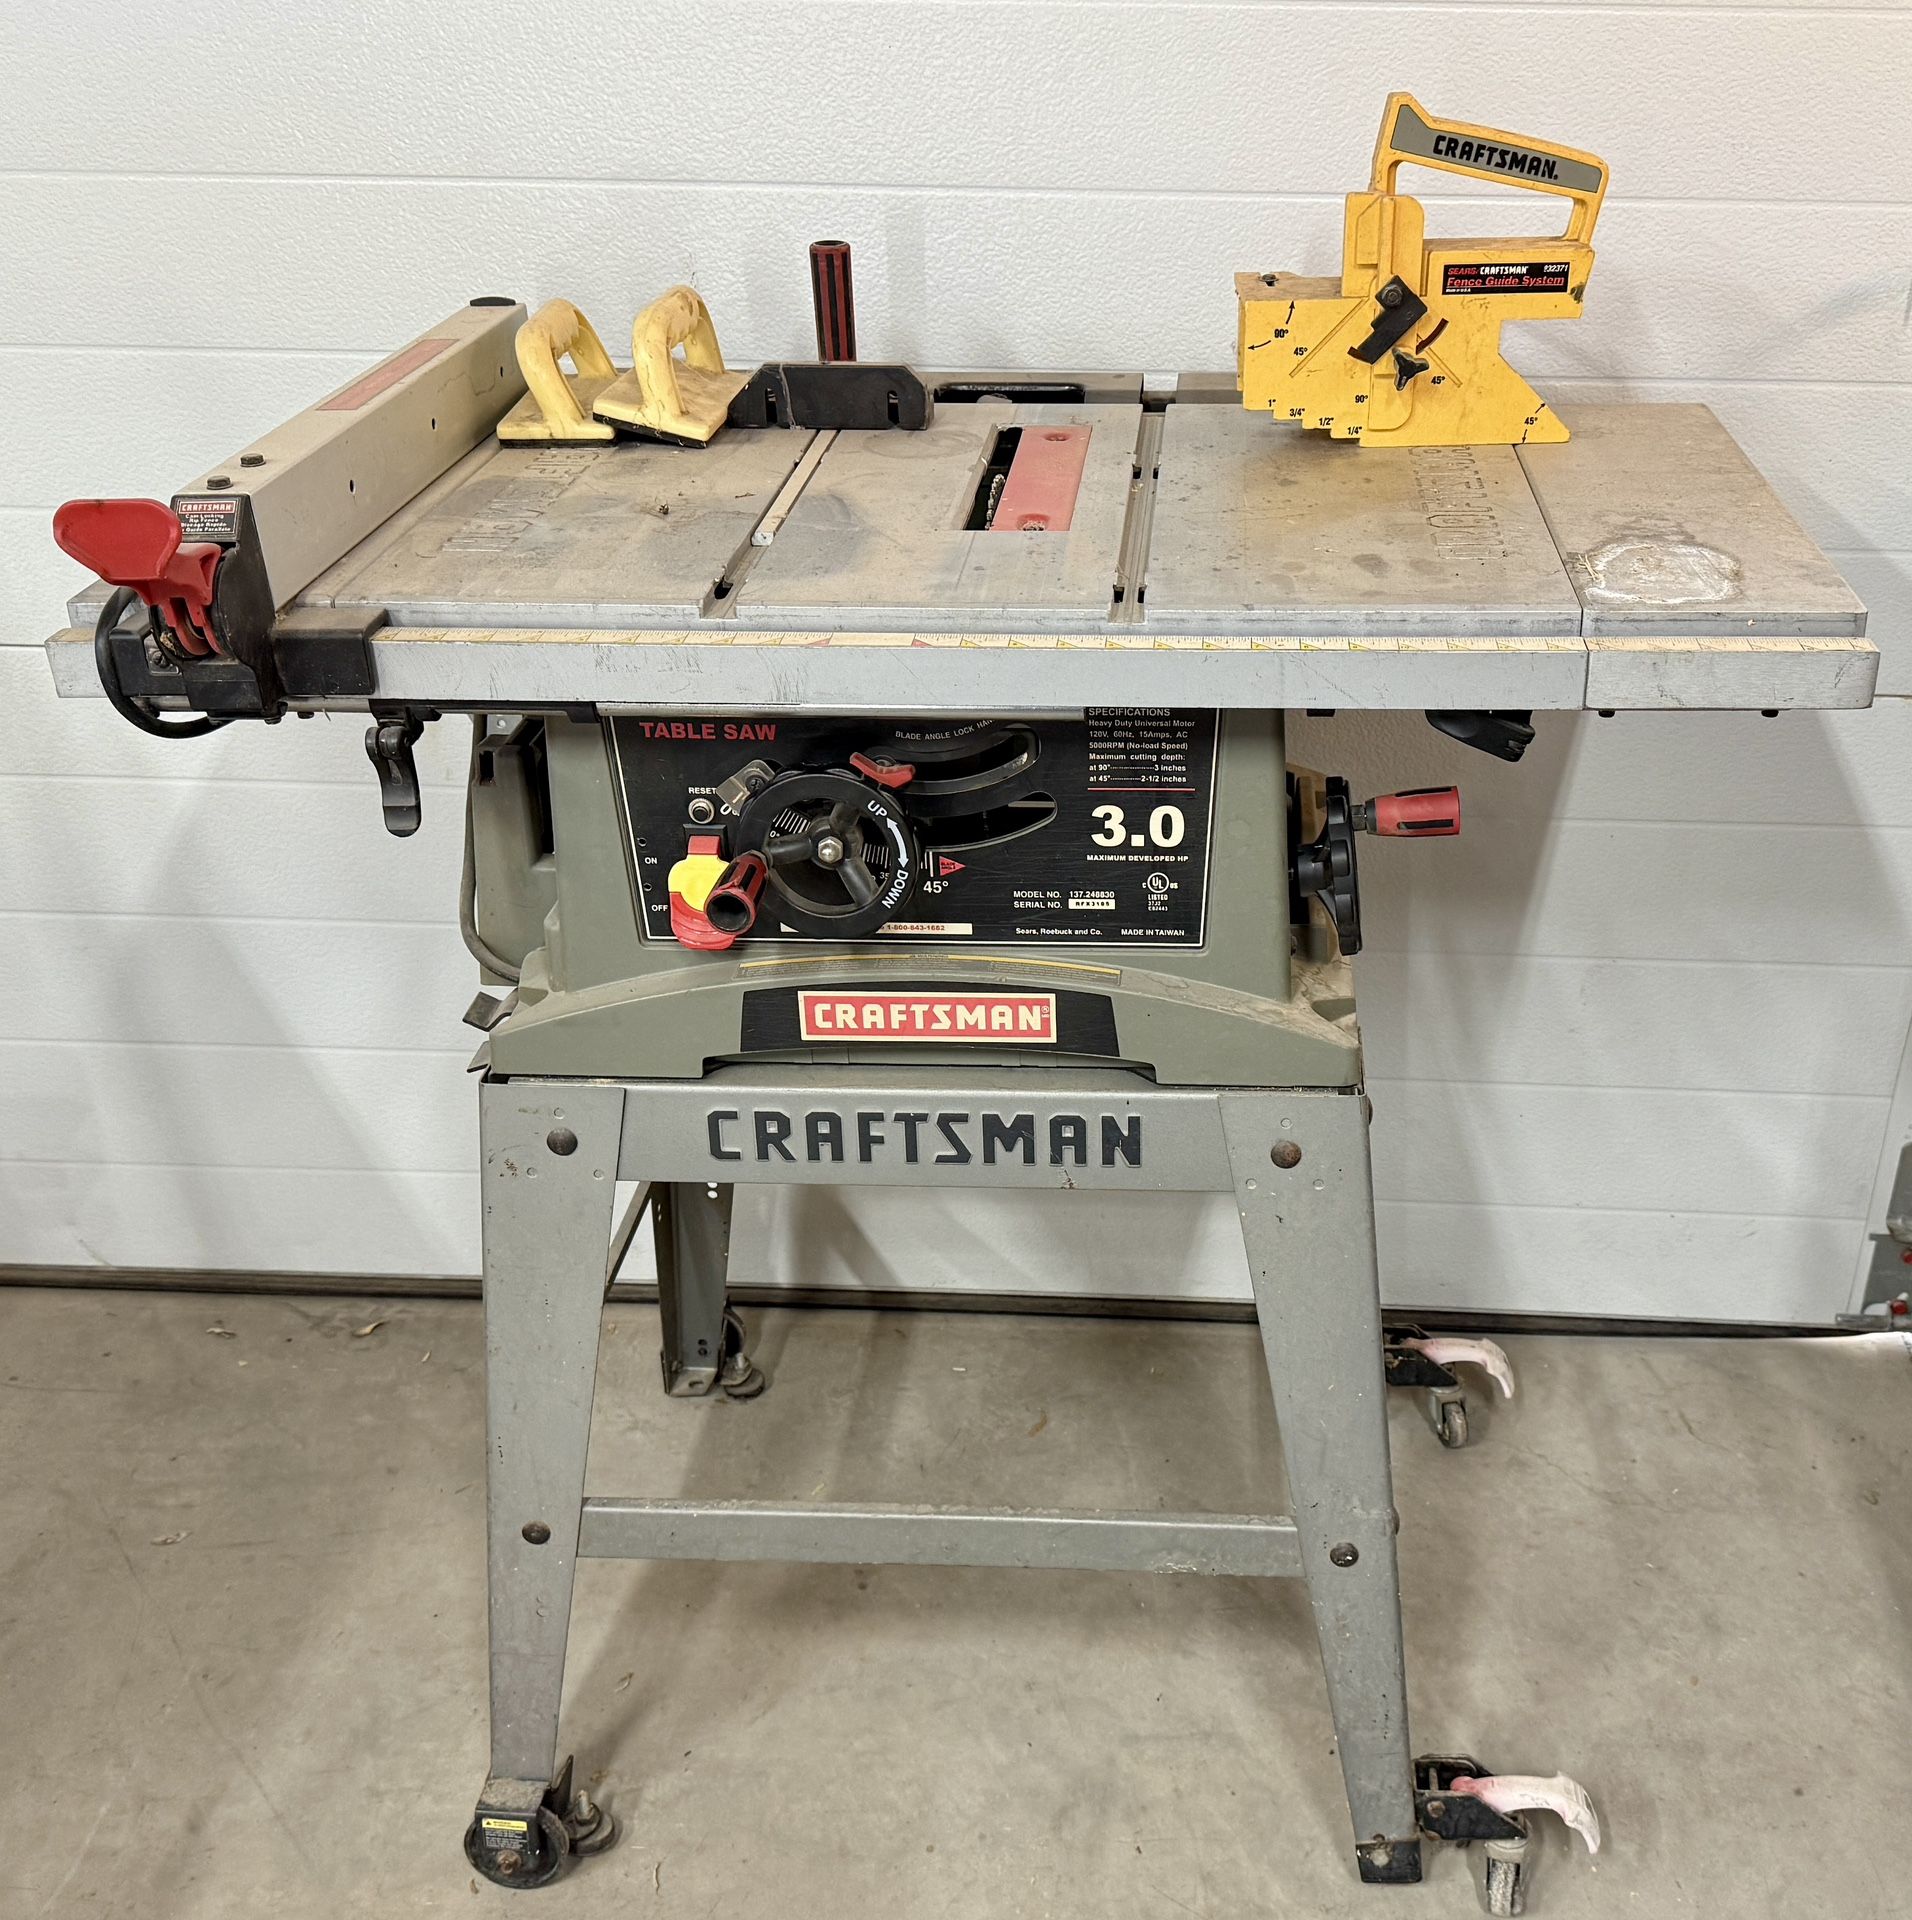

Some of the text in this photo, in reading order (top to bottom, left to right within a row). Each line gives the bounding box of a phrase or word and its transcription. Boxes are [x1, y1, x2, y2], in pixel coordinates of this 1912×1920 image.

[1447, 275, 1565, 287] Fence Guide System
[1293, 347, 1308, 356] 45°
[1431, 375, 1446, 385] 45°
[1355, 395, 1369, 404] 90°
[1524, 416, 1539, 426] 45°
[1088, 707, 1171, 717] SPECIFICATIONS
[1088, 719, 1113, 728] Heavy
[1114, 719, 1133, 728] Duty
[1134, 719, 1171, 727] Universal
[639, 722, 777, 740] TABLE SAW
[895, 730, 921, 741] BLADE
[924, 731, 951, 741] ANGLE
[953, 725, 975, 737] LOCK
[1126, 742, 1160, 750] (No-load
[1161, 742, 1189, 750] Speed)
[1089, 753, 1186, 762] Maximum cutting depth:
[1160, 764, 1187, 772] inches
[1161, 775, 1187, 783] inches
[688, 786, 717, 795] RESET
[867, 800, 888, 817] UP
[1091, 804, 1185, 848] 3.0
[644, 857, 658, 865] ON
[1086, 854, 1127, 862] MAXIMUM
[881, 869, 909, 909] DOWN
[923, 880, 949, 894] 45°
[1013, 890, 1045, 898] MODEL
[1046, 890, 1062, 898] NO.
[651, 904, 668, 912] OFF
[1013, 900, 1046, 909] SERIAL
[1047, 901, 1063, 909] NO.
[1015, 927, 1103, 936] Sears, Roebuck and Co.
[1121, 928, 1185, 936] MADE IN TAIWAN
[707, 1109, 1141, 1168] CRAFTSMAN
